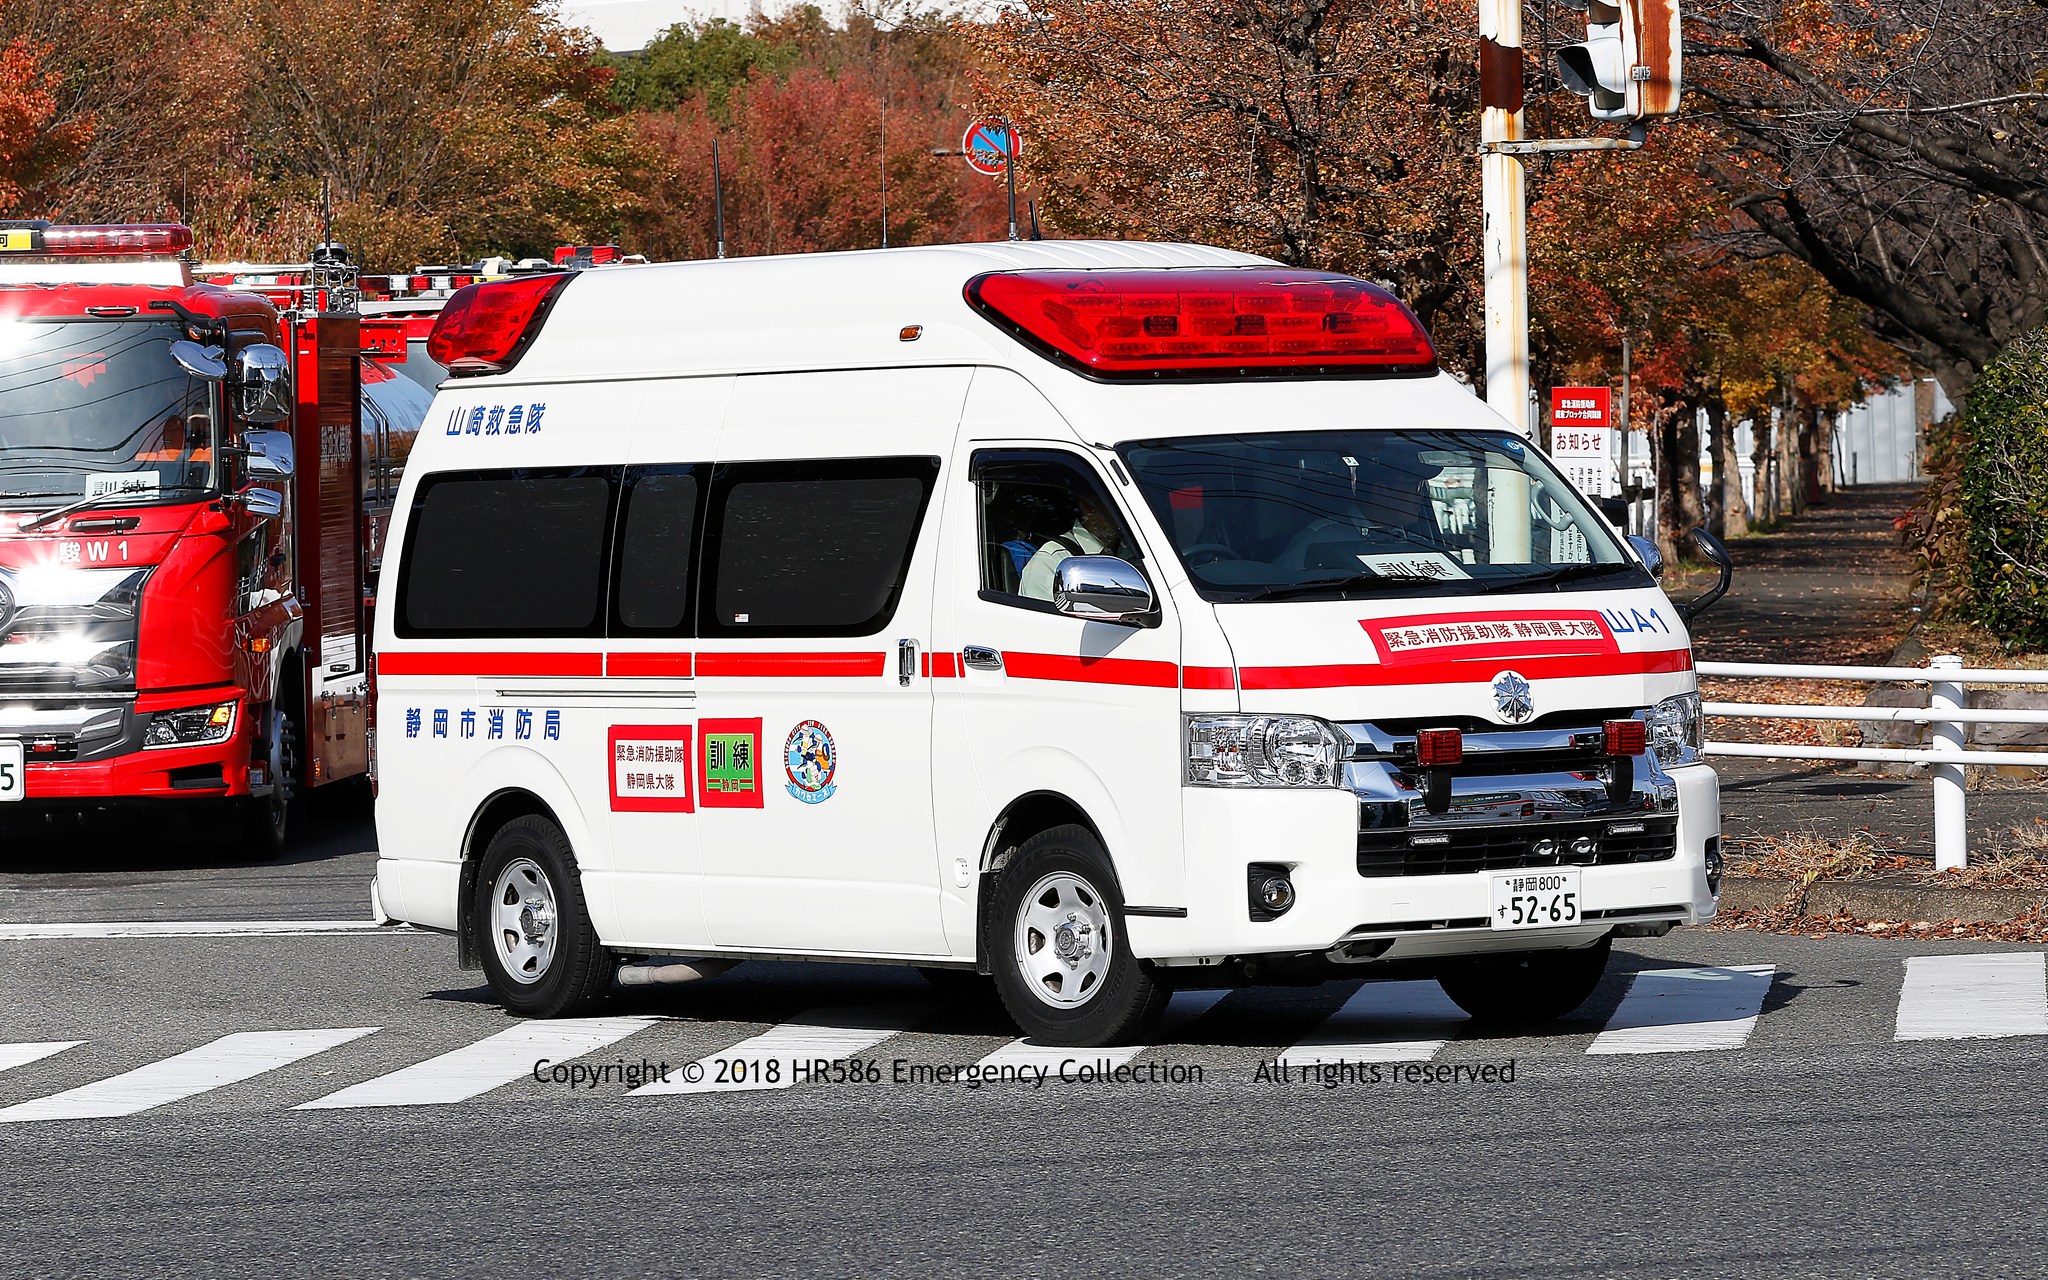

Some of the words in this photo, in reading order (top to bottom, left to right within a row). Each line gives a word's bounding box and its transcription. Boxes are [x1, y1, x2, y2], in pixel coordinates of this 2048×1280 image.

[446, 403, 546, 436] 山崎救急隊
[1557, 433, 1601, 450] お知らせ
[1385, 623, 1511, 649] 緊急消防援助隊
[1512, 620, 1602, 639] 静岡県大隊
[406, 707, 560, 741] 静岡市消防局
[616, 745, 684, 763] 緊急消防援助隊
[709, 740, 750, 770] 訓練
[626, 772, 675, 790] 静岡県大隊
[721, 778, 739, 792] 静岡
[1497, 904, 1508, 919] す
[1511, 893, 1576, 925] 52-65
